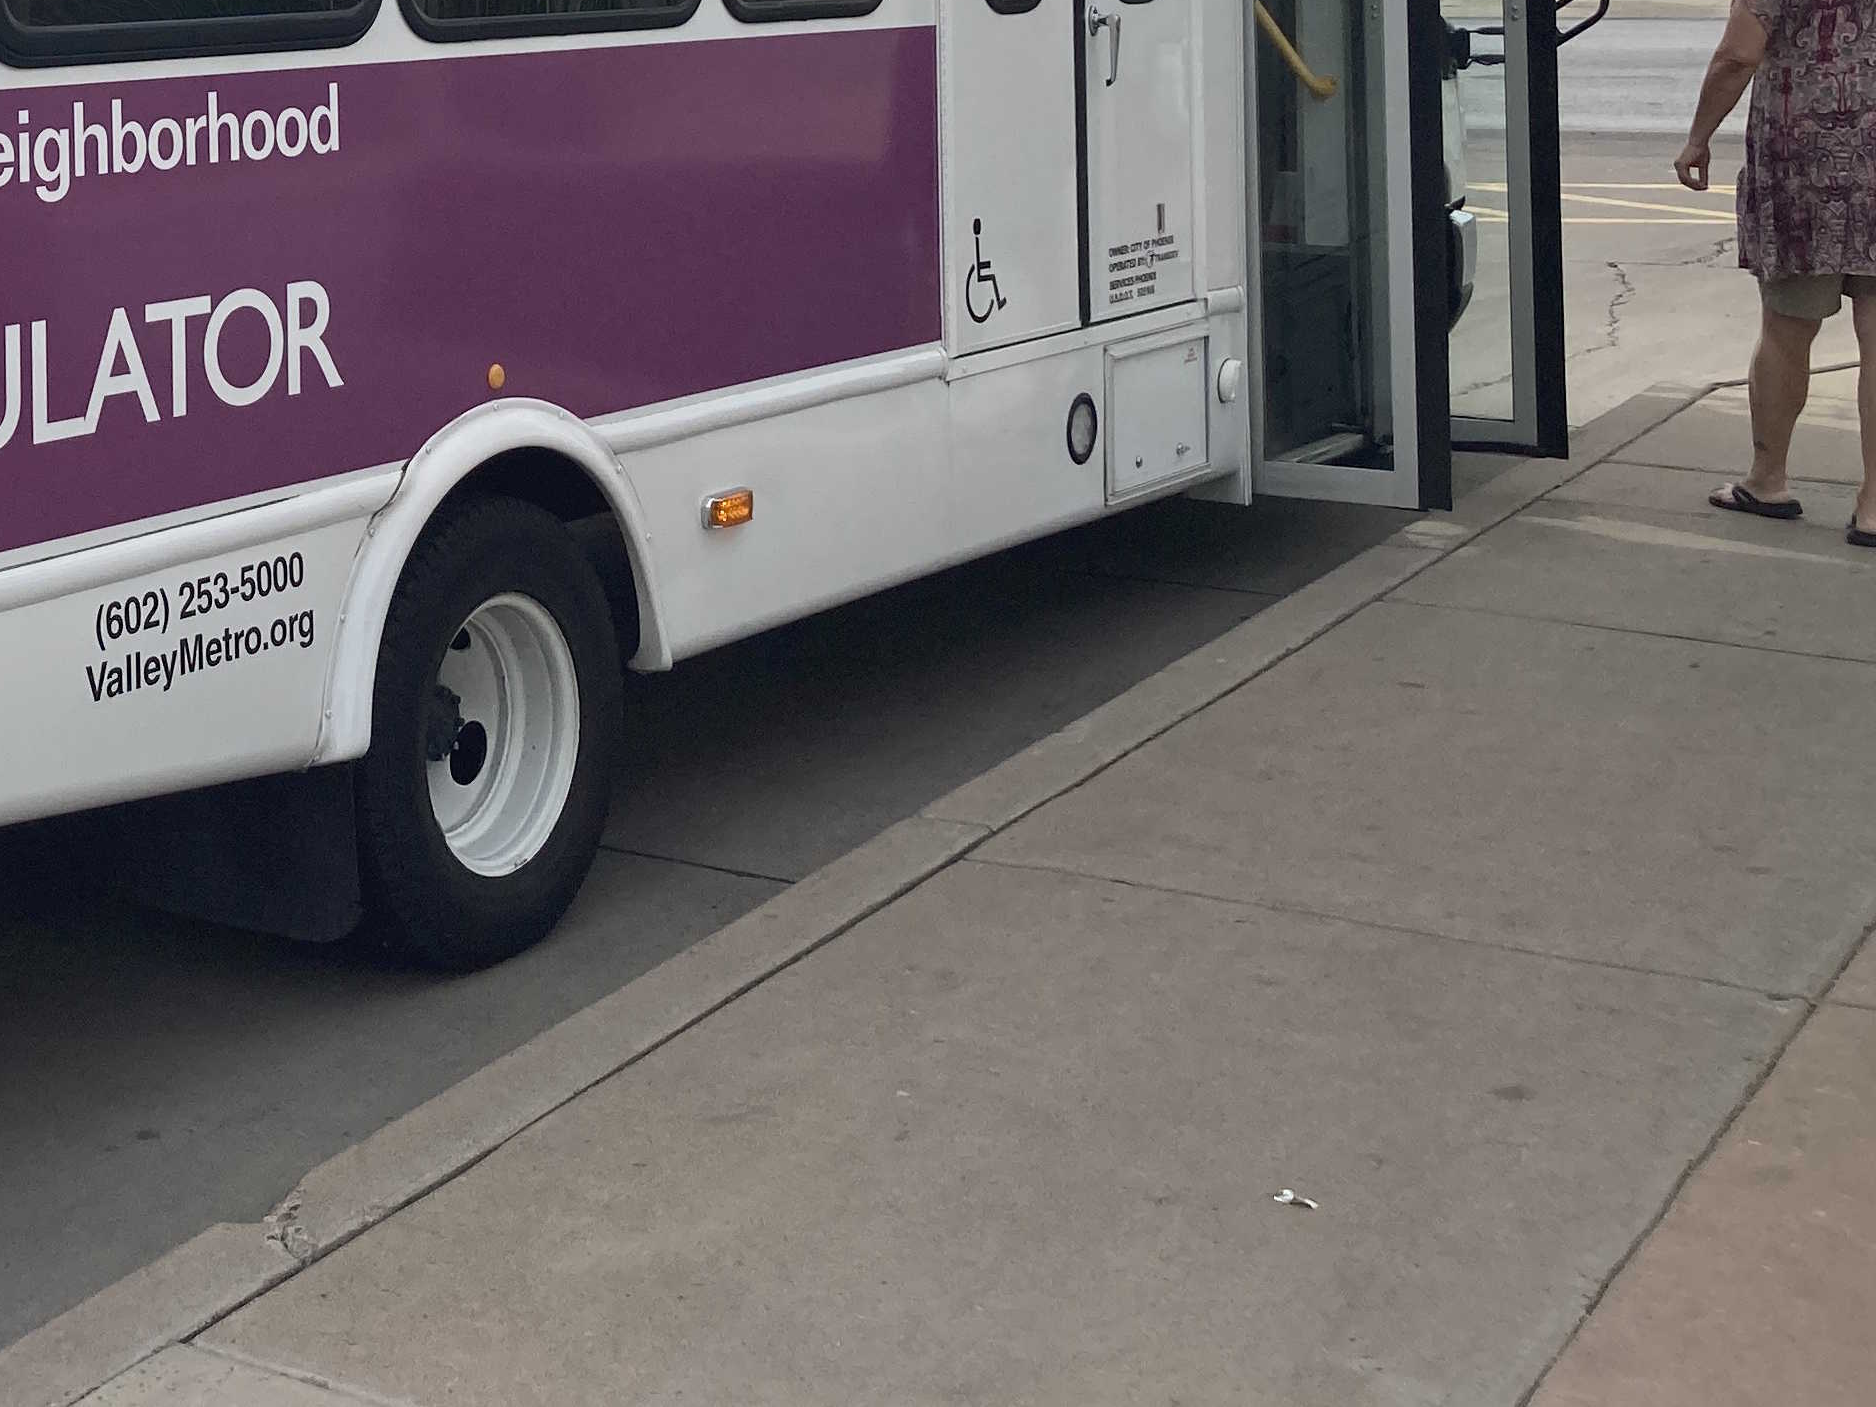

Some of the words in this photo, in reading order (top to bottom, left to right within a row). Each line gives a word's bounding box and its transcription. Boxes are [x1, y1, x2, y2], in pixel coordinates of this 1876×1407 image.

[96, 588, 170, 651] (602)
[179, 551, 305, 620] 253-5000
[86, 609, 315, 703] ValleyMetro.org
